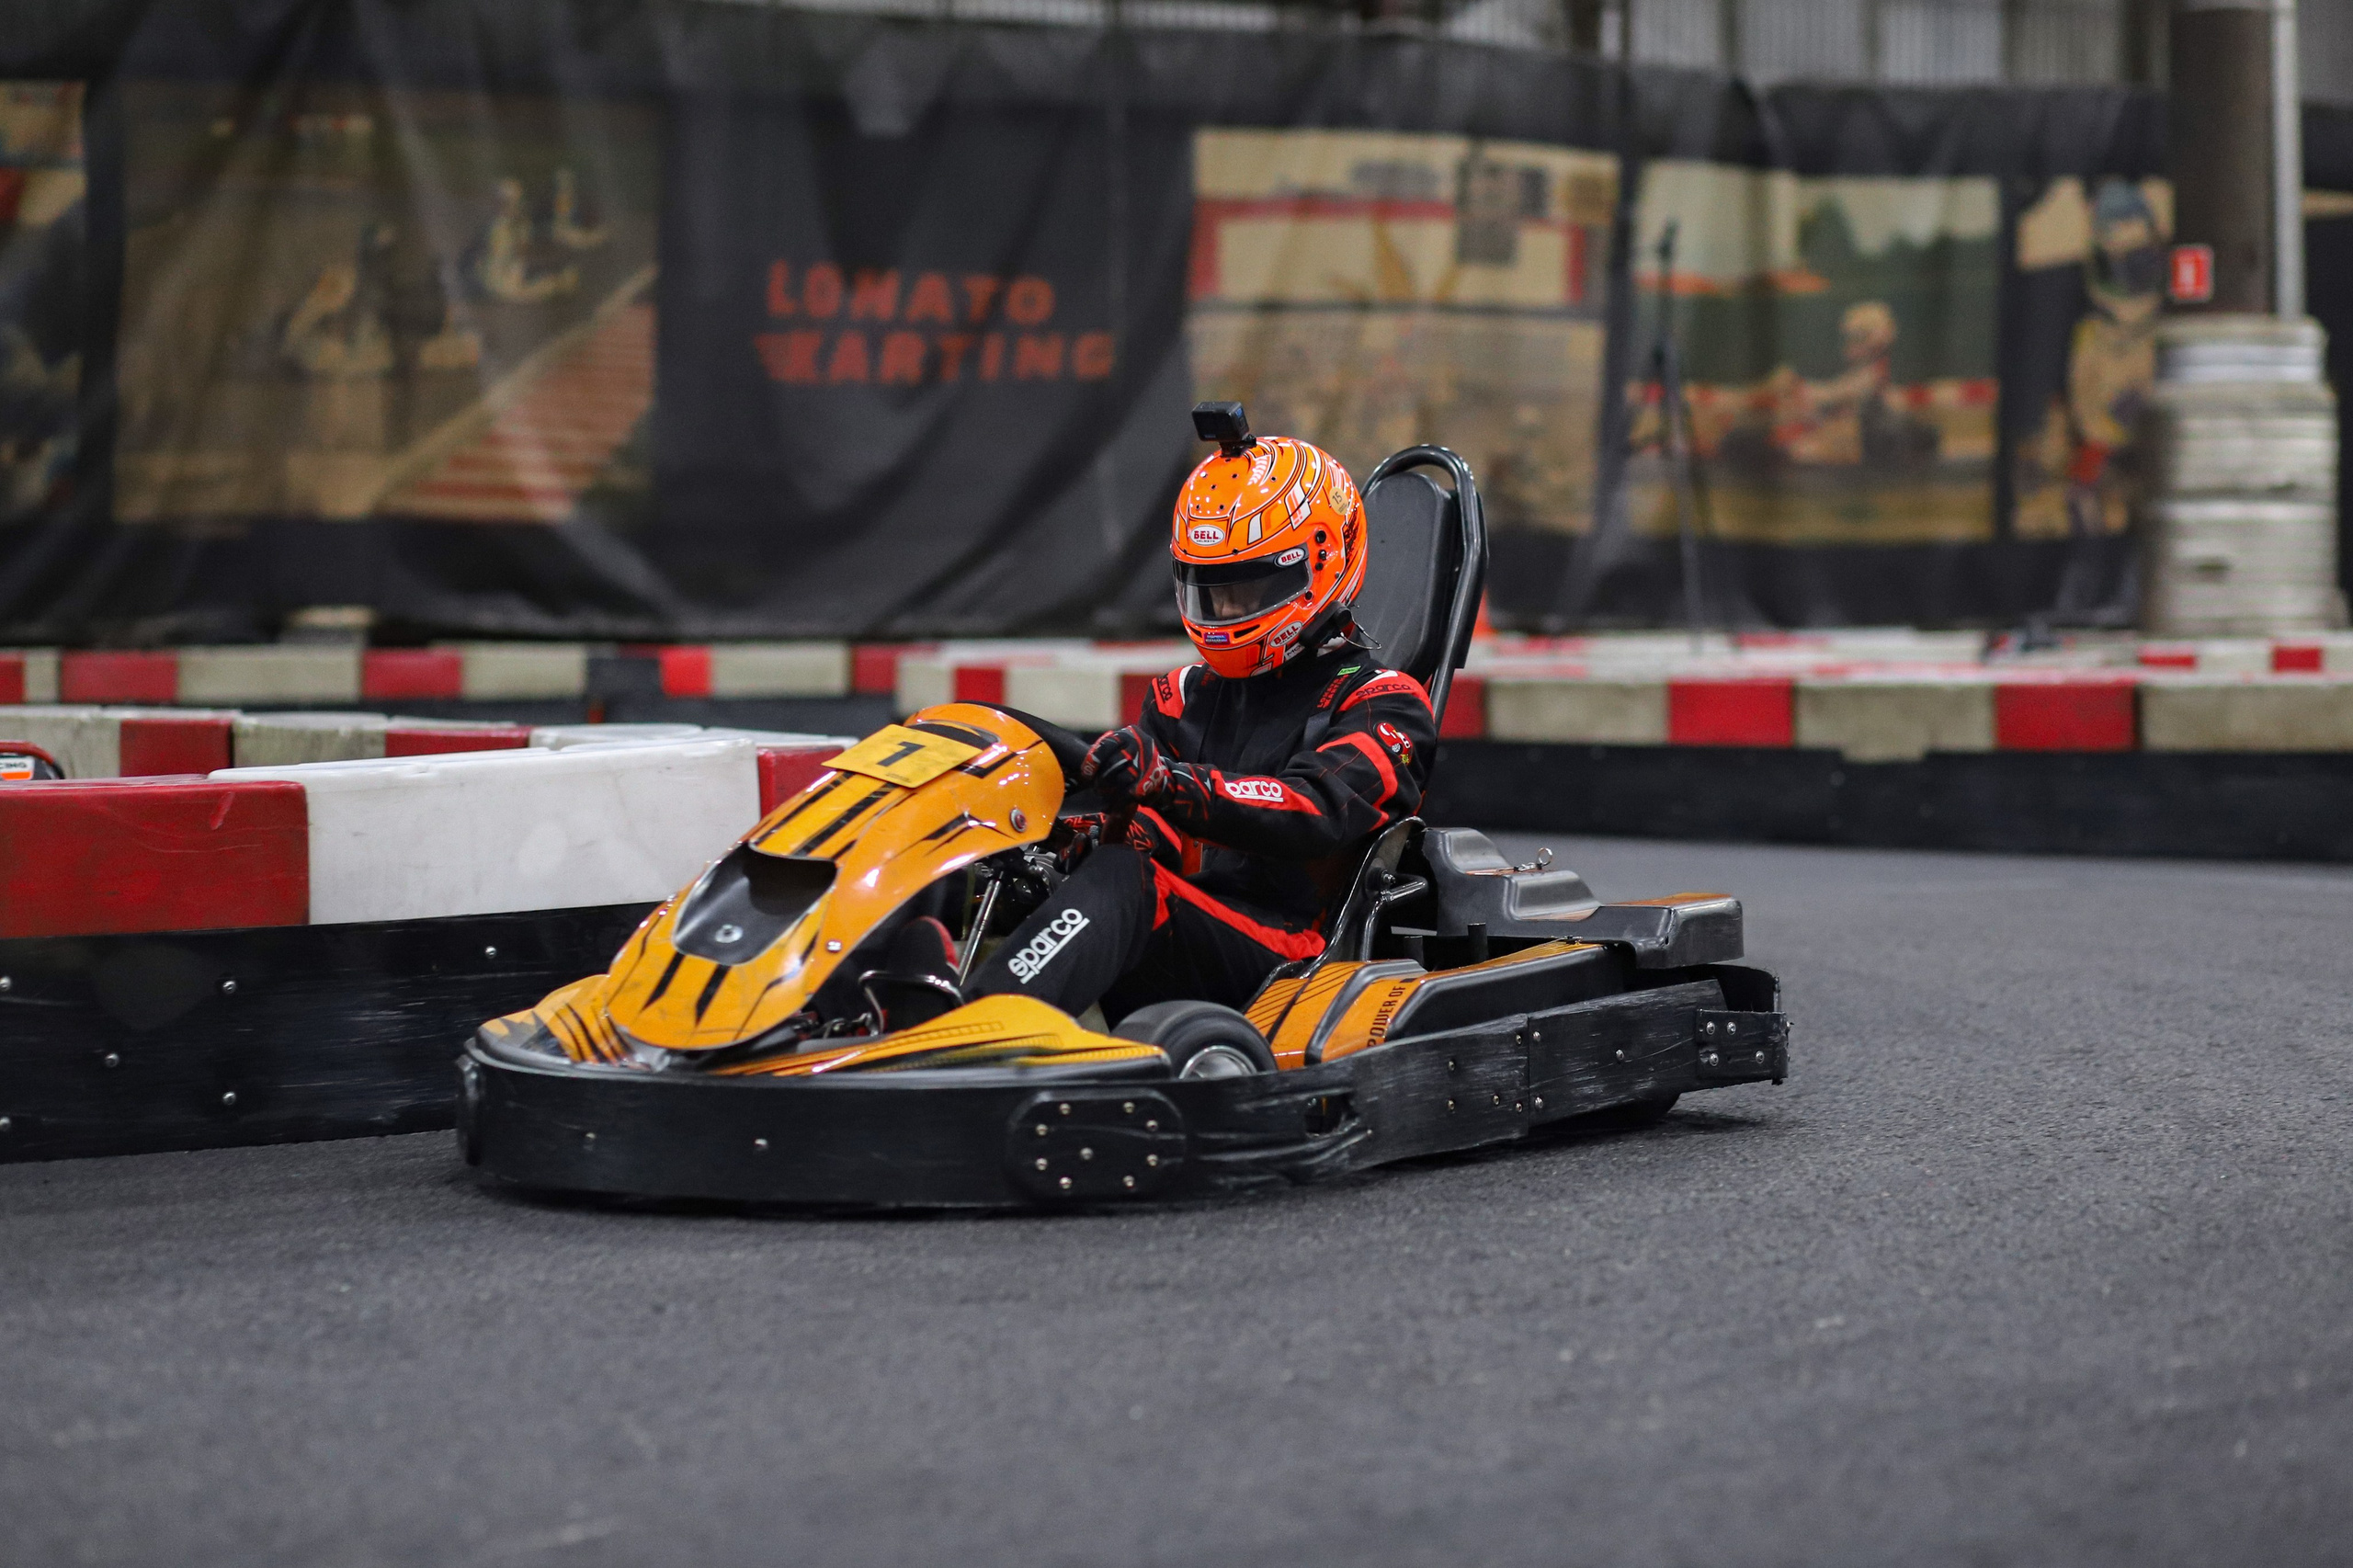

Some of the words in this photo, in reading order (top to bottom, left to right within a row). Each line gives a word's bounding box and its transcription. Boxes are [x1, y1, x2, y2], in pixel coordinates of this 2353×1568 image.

[754, 328, 1114, 386] KARTING
[1332, 491, 1343, 505] 15
[1194, 530, 1219, 540] BELL
[1280, 551, 1301, 562] BELL
[1274, 625, 1299, 645] BELL
[1356, 683, 1412, 698] sparco
[876, 741, 926, 767] 1
[1225, 780, 1284, 802] parco
[1007, 908, 1090, 984] sparco
[1367, 1000, 1398, 1047] POWER
[1388, 985, 1406, 997] OF
